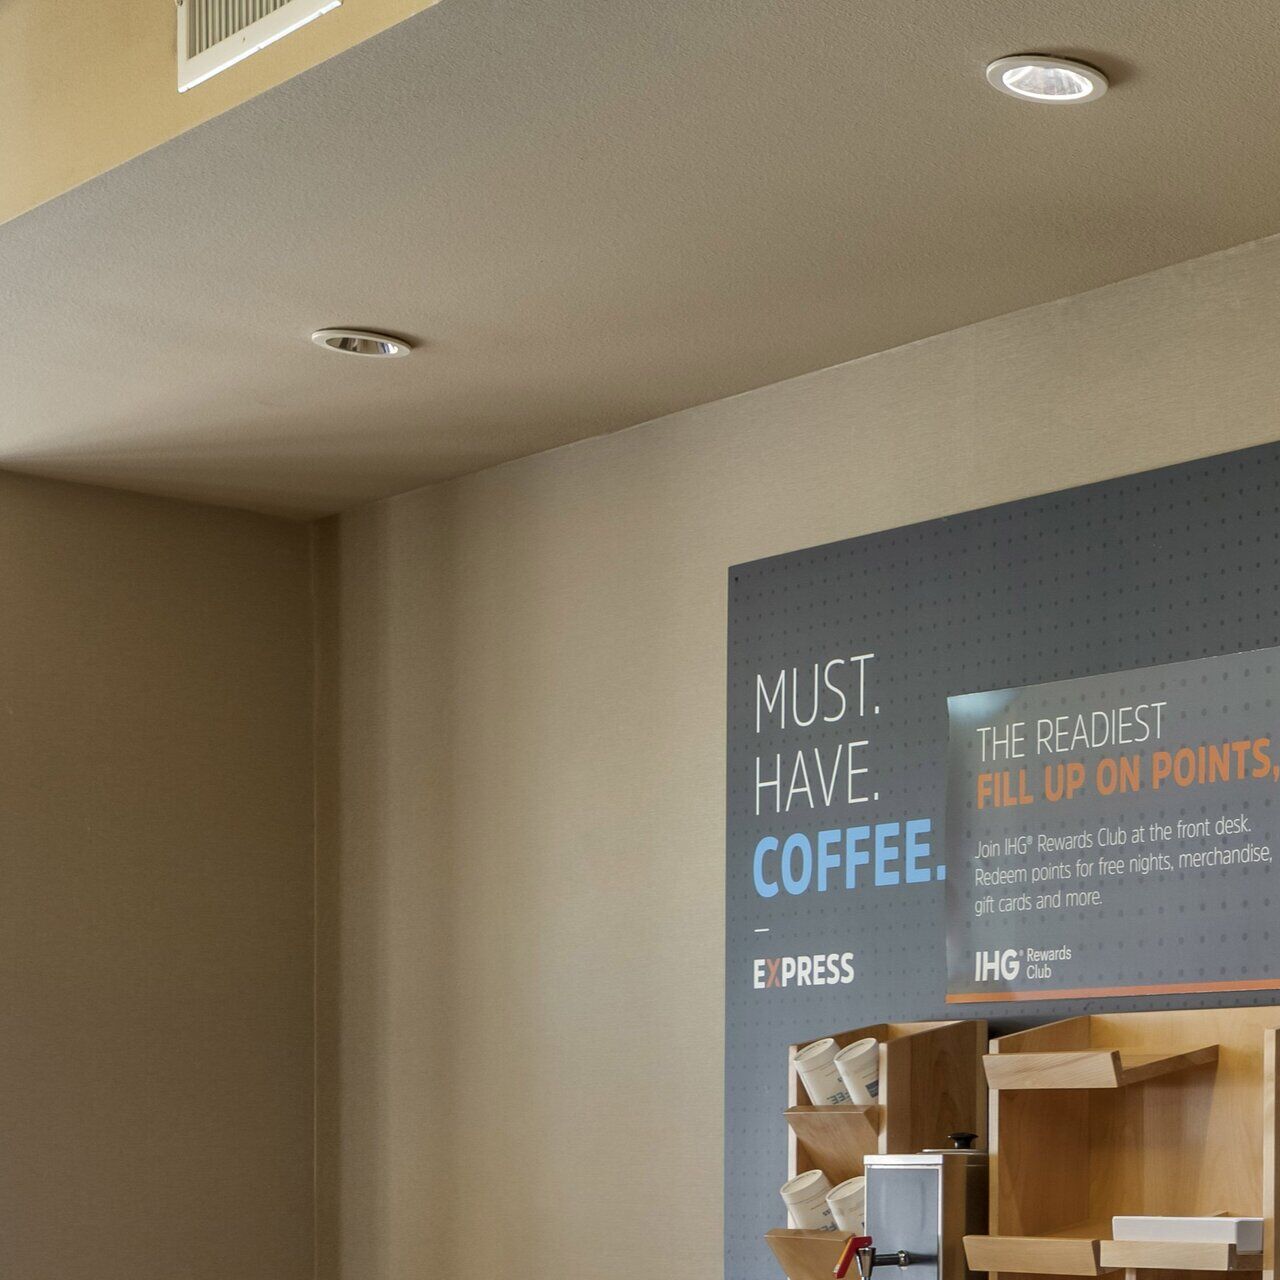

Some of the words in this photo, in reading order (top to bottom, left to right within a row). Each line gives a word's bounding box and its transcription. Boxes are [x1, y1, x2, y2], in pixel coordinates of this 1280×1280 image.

[756, 654, 879, 733] MUST.
[977, 723, 1025, 762] THE
[1037, 702, 1167, 754] READIEST
[756, 741, 879, 815] HAVE.
[977, 769, 1034, 809] FILL
[1045, 762, 1086, 802] UP
[1096, 757, 1140, 796] ON
[1152, 737, 1280, 790] POINTS,
[974, 841, 1000, 858] Join
[1037, 831, 1093, 852] Rewards
[1097, 827, 1127, 846] Club
[1131, 826, 1145, 842] at
[1148, 823, 1172, 841] the
[1176, 819, 1210, 838] front
[1214, 814, 1251, 835] desk.
[753, 820, 946, 898] COFFEE.
[975, 867, 1027, 886] Redeem
[1031, 862, 1071, 883] points
[1075, 859, 1094, 877] for
[1098, 857, 1124, 875] free
[1129, 853, 1173, 874] nights,
[1178, 845, 1272, 868] merchandise,
[974, 896, 994, 916] gift
[998, 894, 1032, 912] cards
[1035, 890, 1060, 909] and
[1065, 891, 1102, 906] more.
[754, 953, 854, 989] EXPRESS
[1026, 945, 1071, 962] Rewards
[1026, 964, 1051, 979] Club
